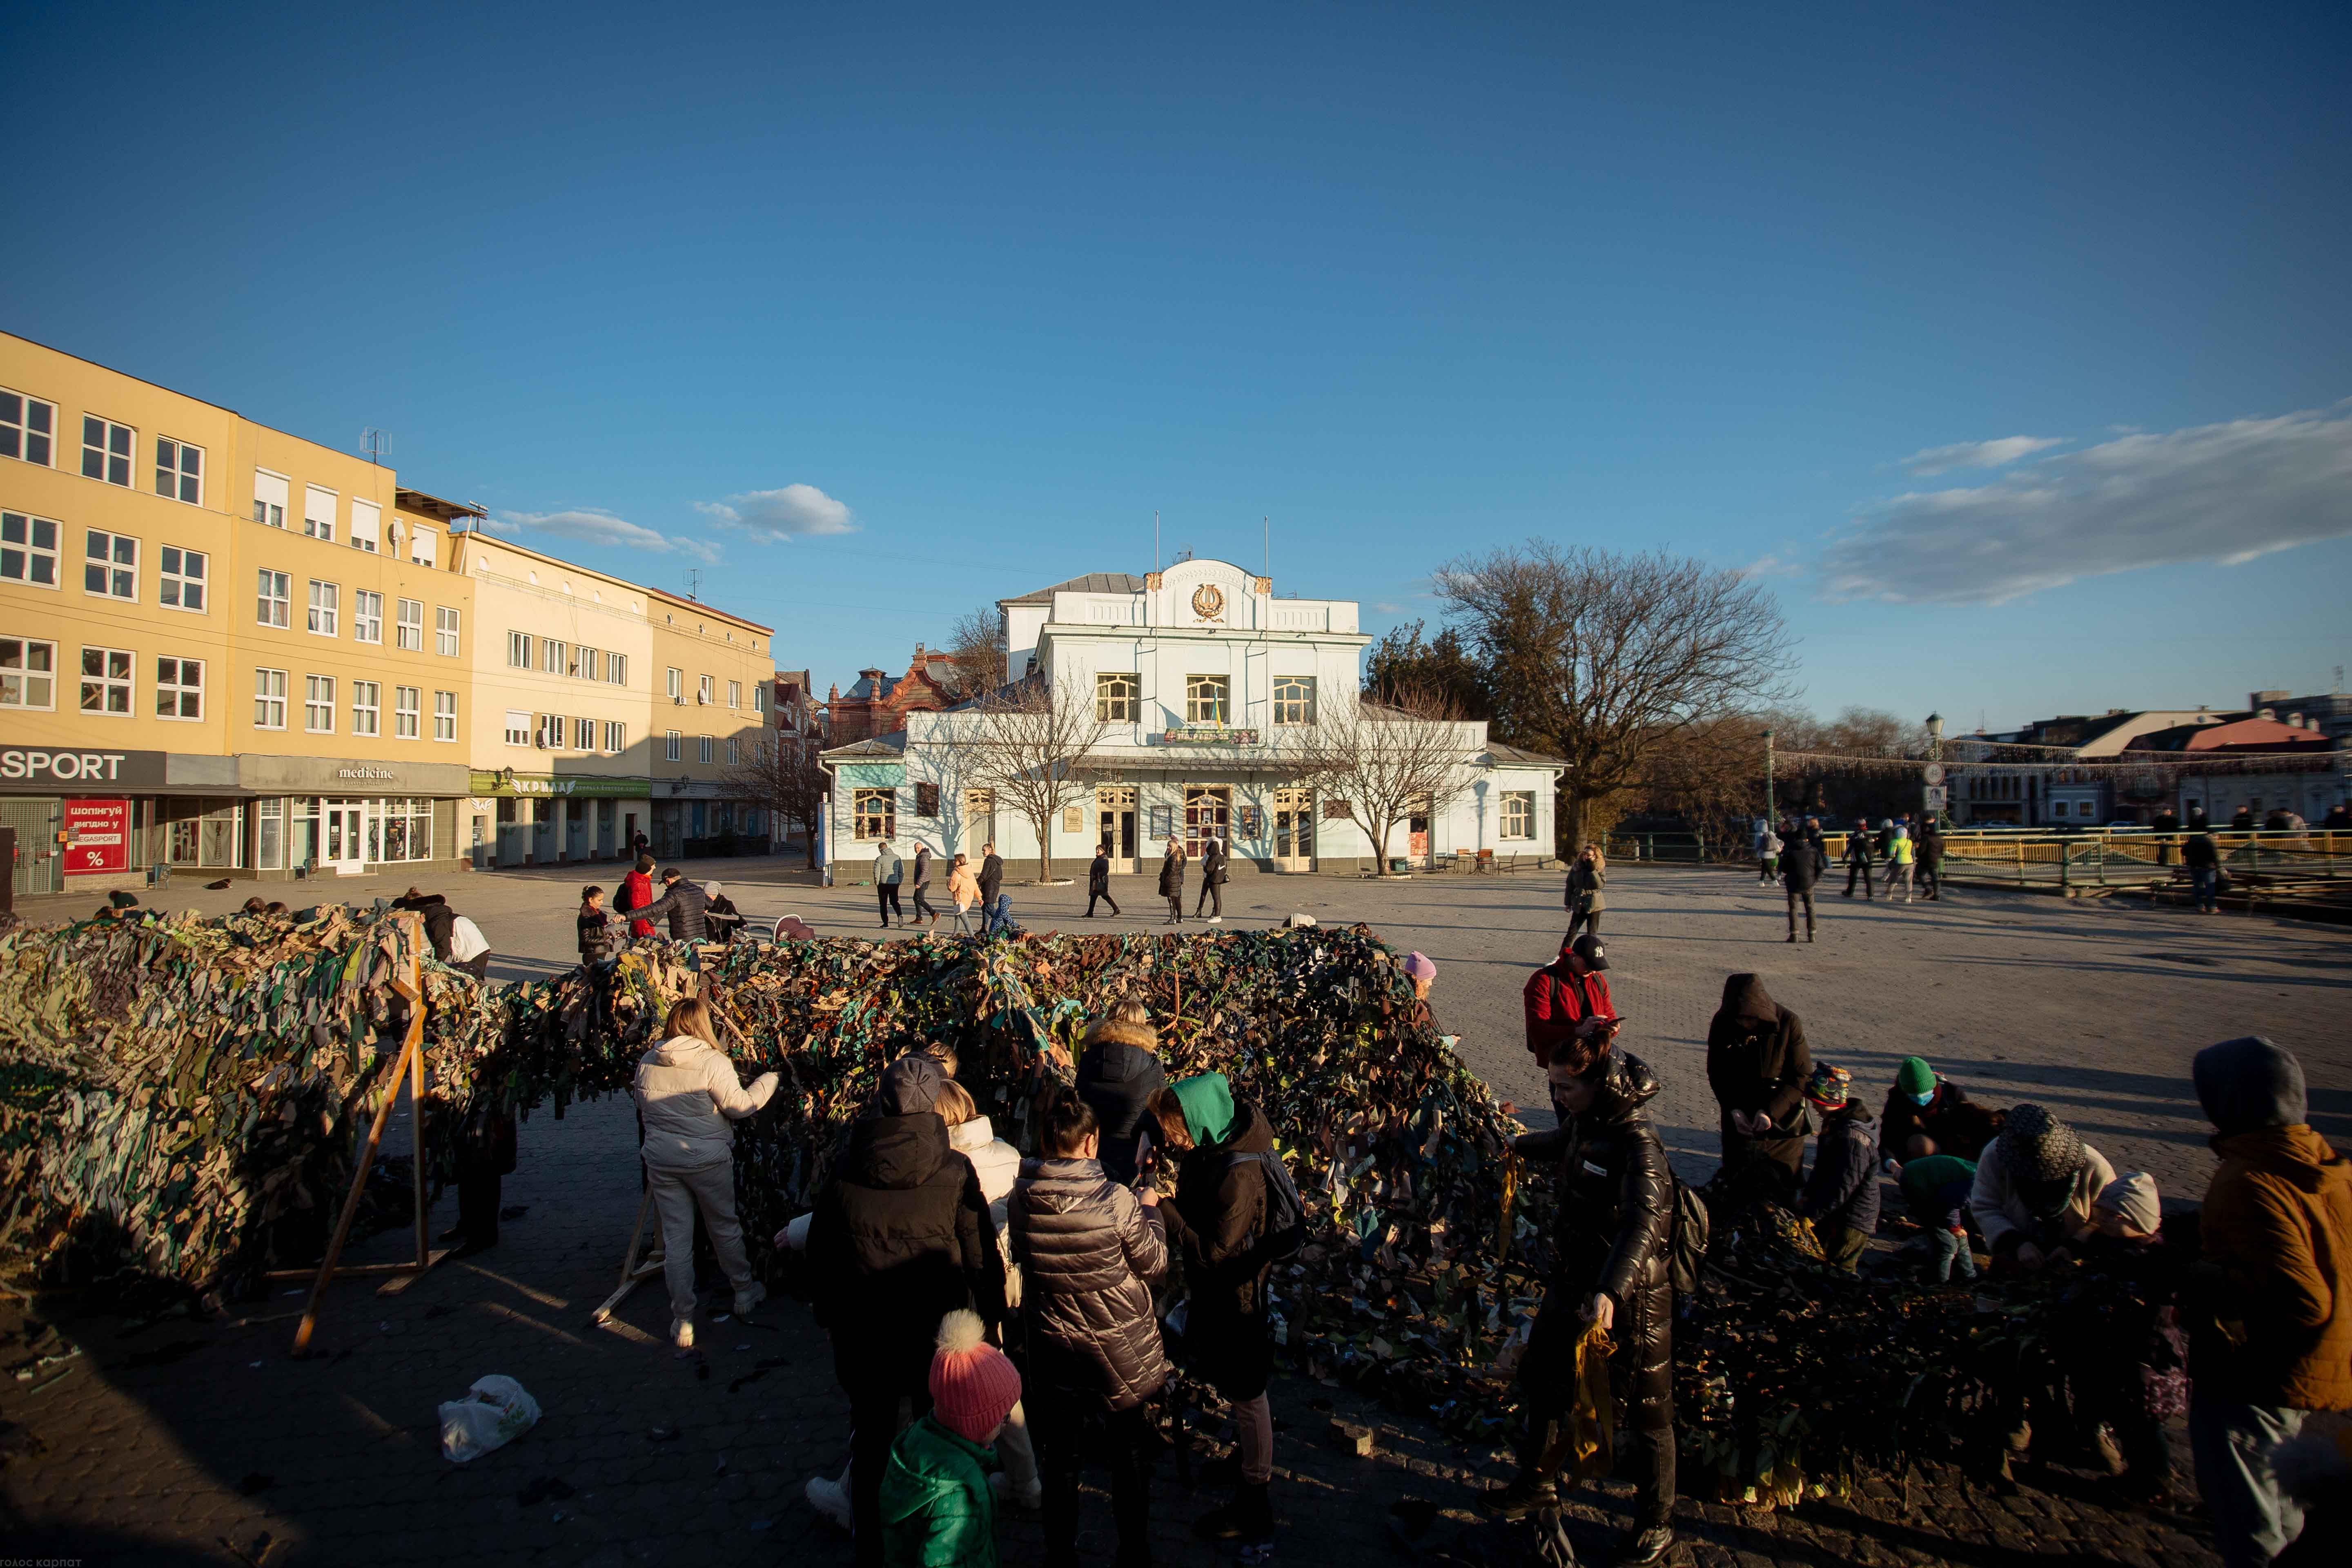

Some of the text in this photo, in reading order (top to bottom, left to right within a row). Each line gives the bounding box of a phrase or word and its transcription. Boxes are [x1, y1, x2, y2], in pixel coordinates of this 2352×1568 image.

[0, 751, 125, 780] SPORT
[339, 766, 393, 779] medicine
[522, 781, 566, 793] КРИЛА
[71, 806, 122, 817] шопінгуй
[112, 821, 119, 829] у
[1594, 946, 1604, 957] NY
